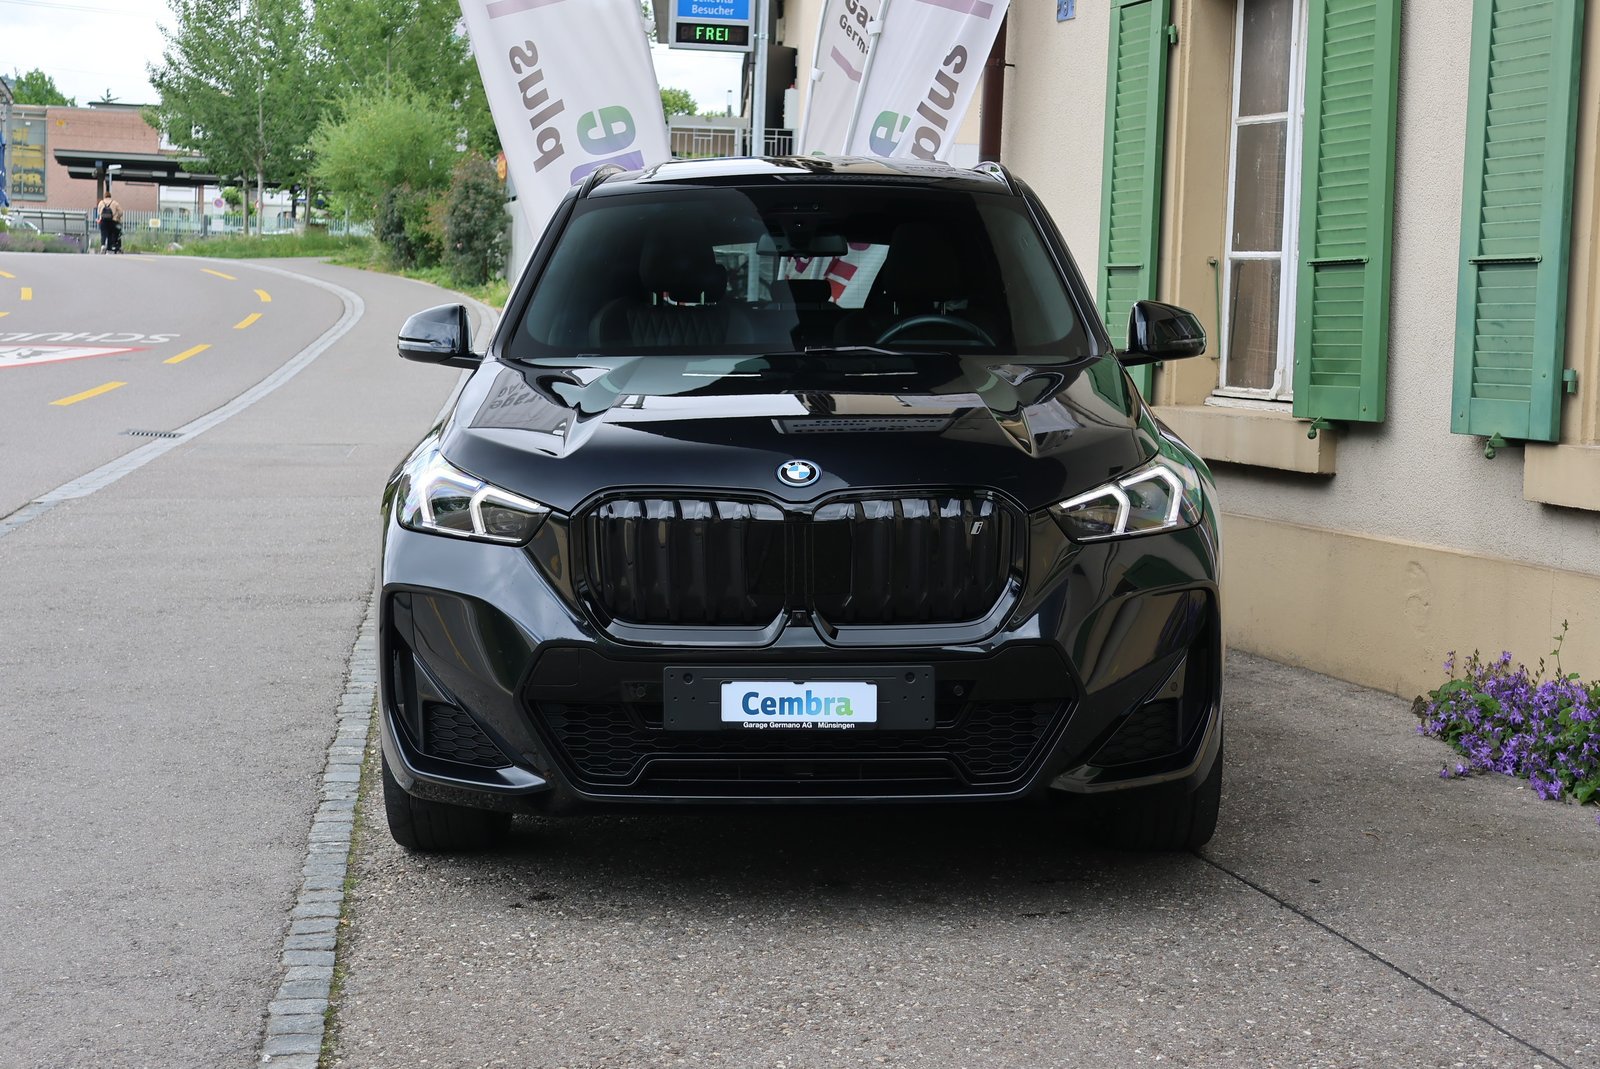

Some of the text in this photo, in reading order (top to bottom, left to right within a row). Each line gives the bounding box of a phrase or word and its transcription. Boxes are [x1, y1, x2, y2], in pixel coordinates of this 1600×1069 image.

[691, 4, 735, 16] Besucher
[695, 26, 729, 41] FREI
[911, 44, 969, 161] plus
[0, 331, 181, 344] SCHUL
[741, 689, 854, 716] Cembra
[743, 721, 855, 730] Garage Germano AG Münsingen
